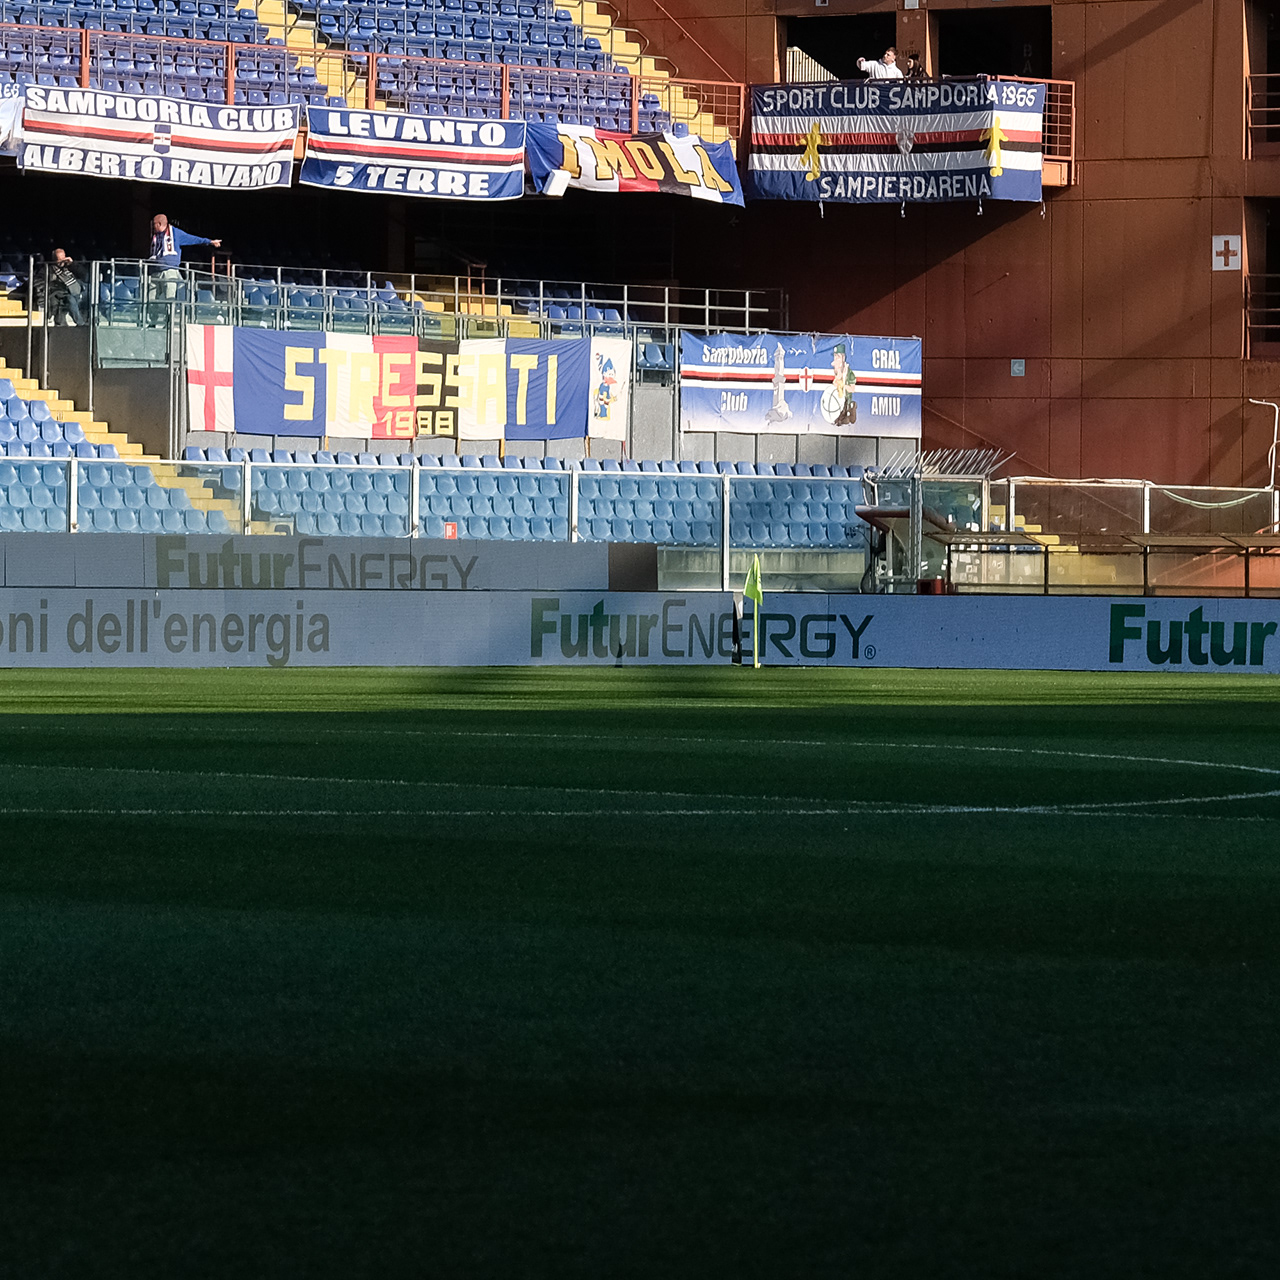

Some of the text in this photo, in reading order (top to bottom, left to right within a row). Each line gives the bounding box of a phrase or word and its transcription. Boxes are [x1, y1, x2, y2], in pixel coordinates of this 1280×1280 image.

[26, 87, 294, 132] SAMPDORIA CLUB
[762, 84, 1038, 112] SPORT CLUB SAMPDORIA 1966
[328, 108, 507, 147] LEVANTO
[23, 144, 283, 187] ALBERTO RAVANO
[333, 164, 490, 196] 5 TERRE
[557, 133, 735, 195] IMOLA
[820, 174, 992, 199] SAMPIERDARENA
[702, 344, 768, 365] Sampdoria
[871, 348, 901, 370] CRAL
[283, 346, 558, 426] STRESSATI
[720, 391, 748, 413] Club
[380, 410, 455, 437] 1988
[871, 396, 901, 417] AMIU
[155, 535, 479, 590] FuturENERGY
[66, 600, 330, 668] dell'energia
[530, 598, 874, 660] FuturENERGY
